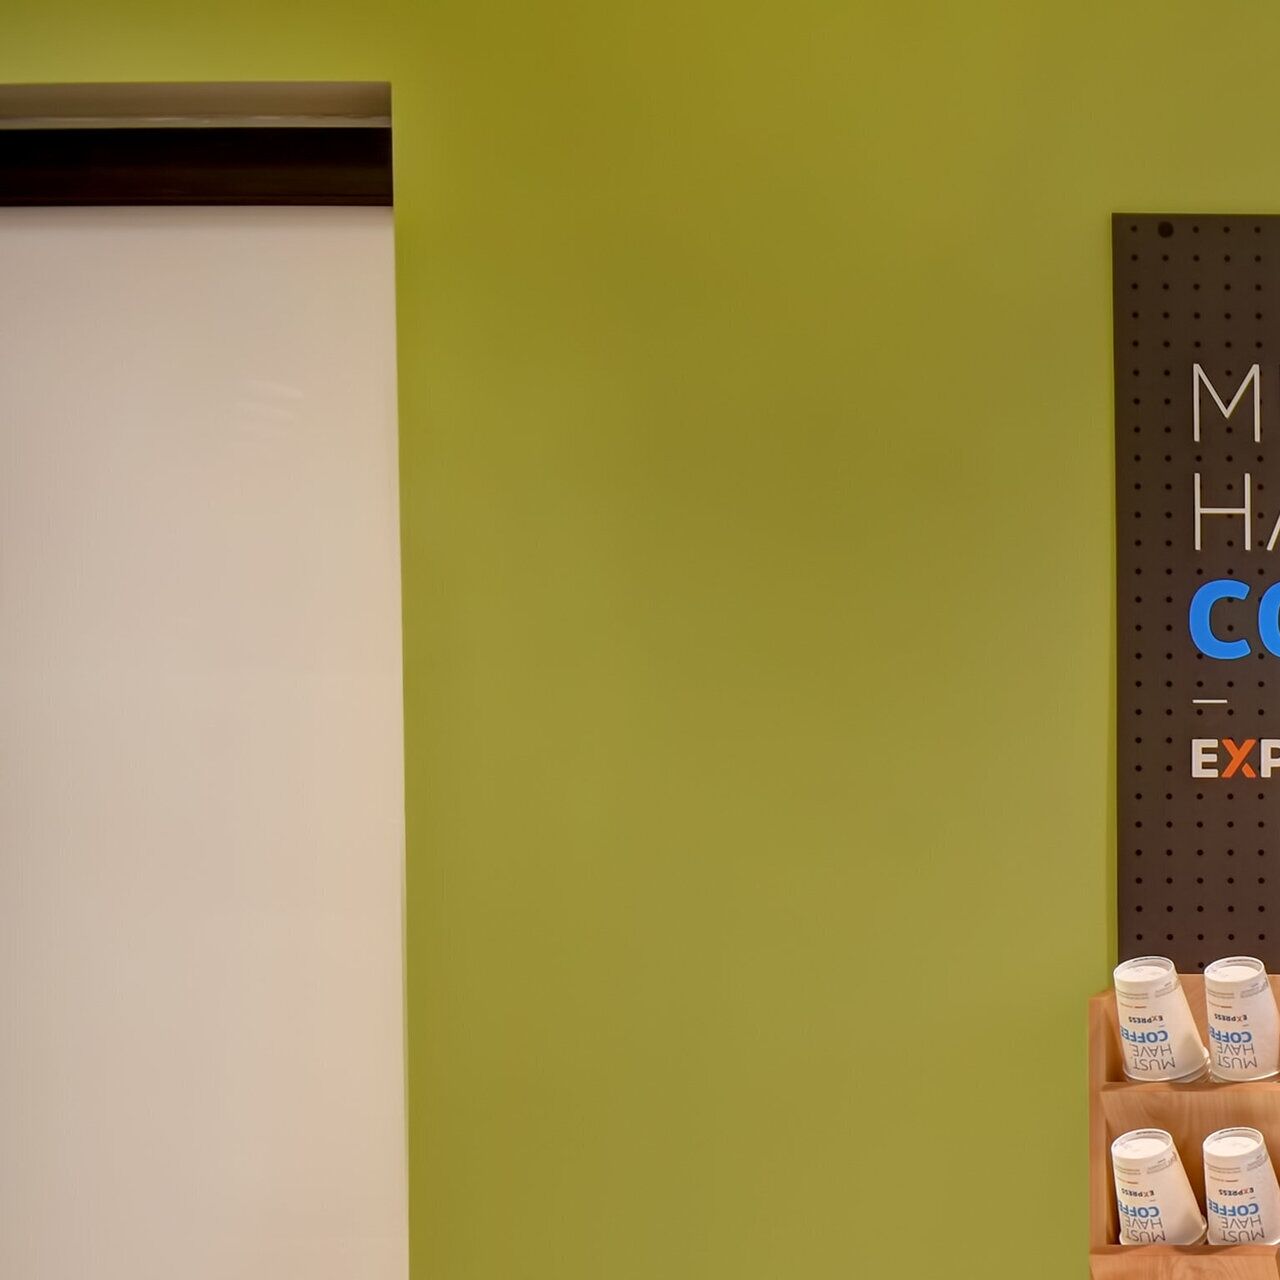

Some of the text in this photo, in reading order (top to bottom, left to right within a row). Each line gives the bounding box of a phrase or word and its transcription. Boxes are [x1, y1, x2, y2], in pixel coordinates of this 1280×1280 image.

[1128, 1016, 1163, 1024] EXPRESS
[1214, 1013, 1248, 1023] EXPRESS
[1218, 1187, 1254, 1196] EXPRESS
